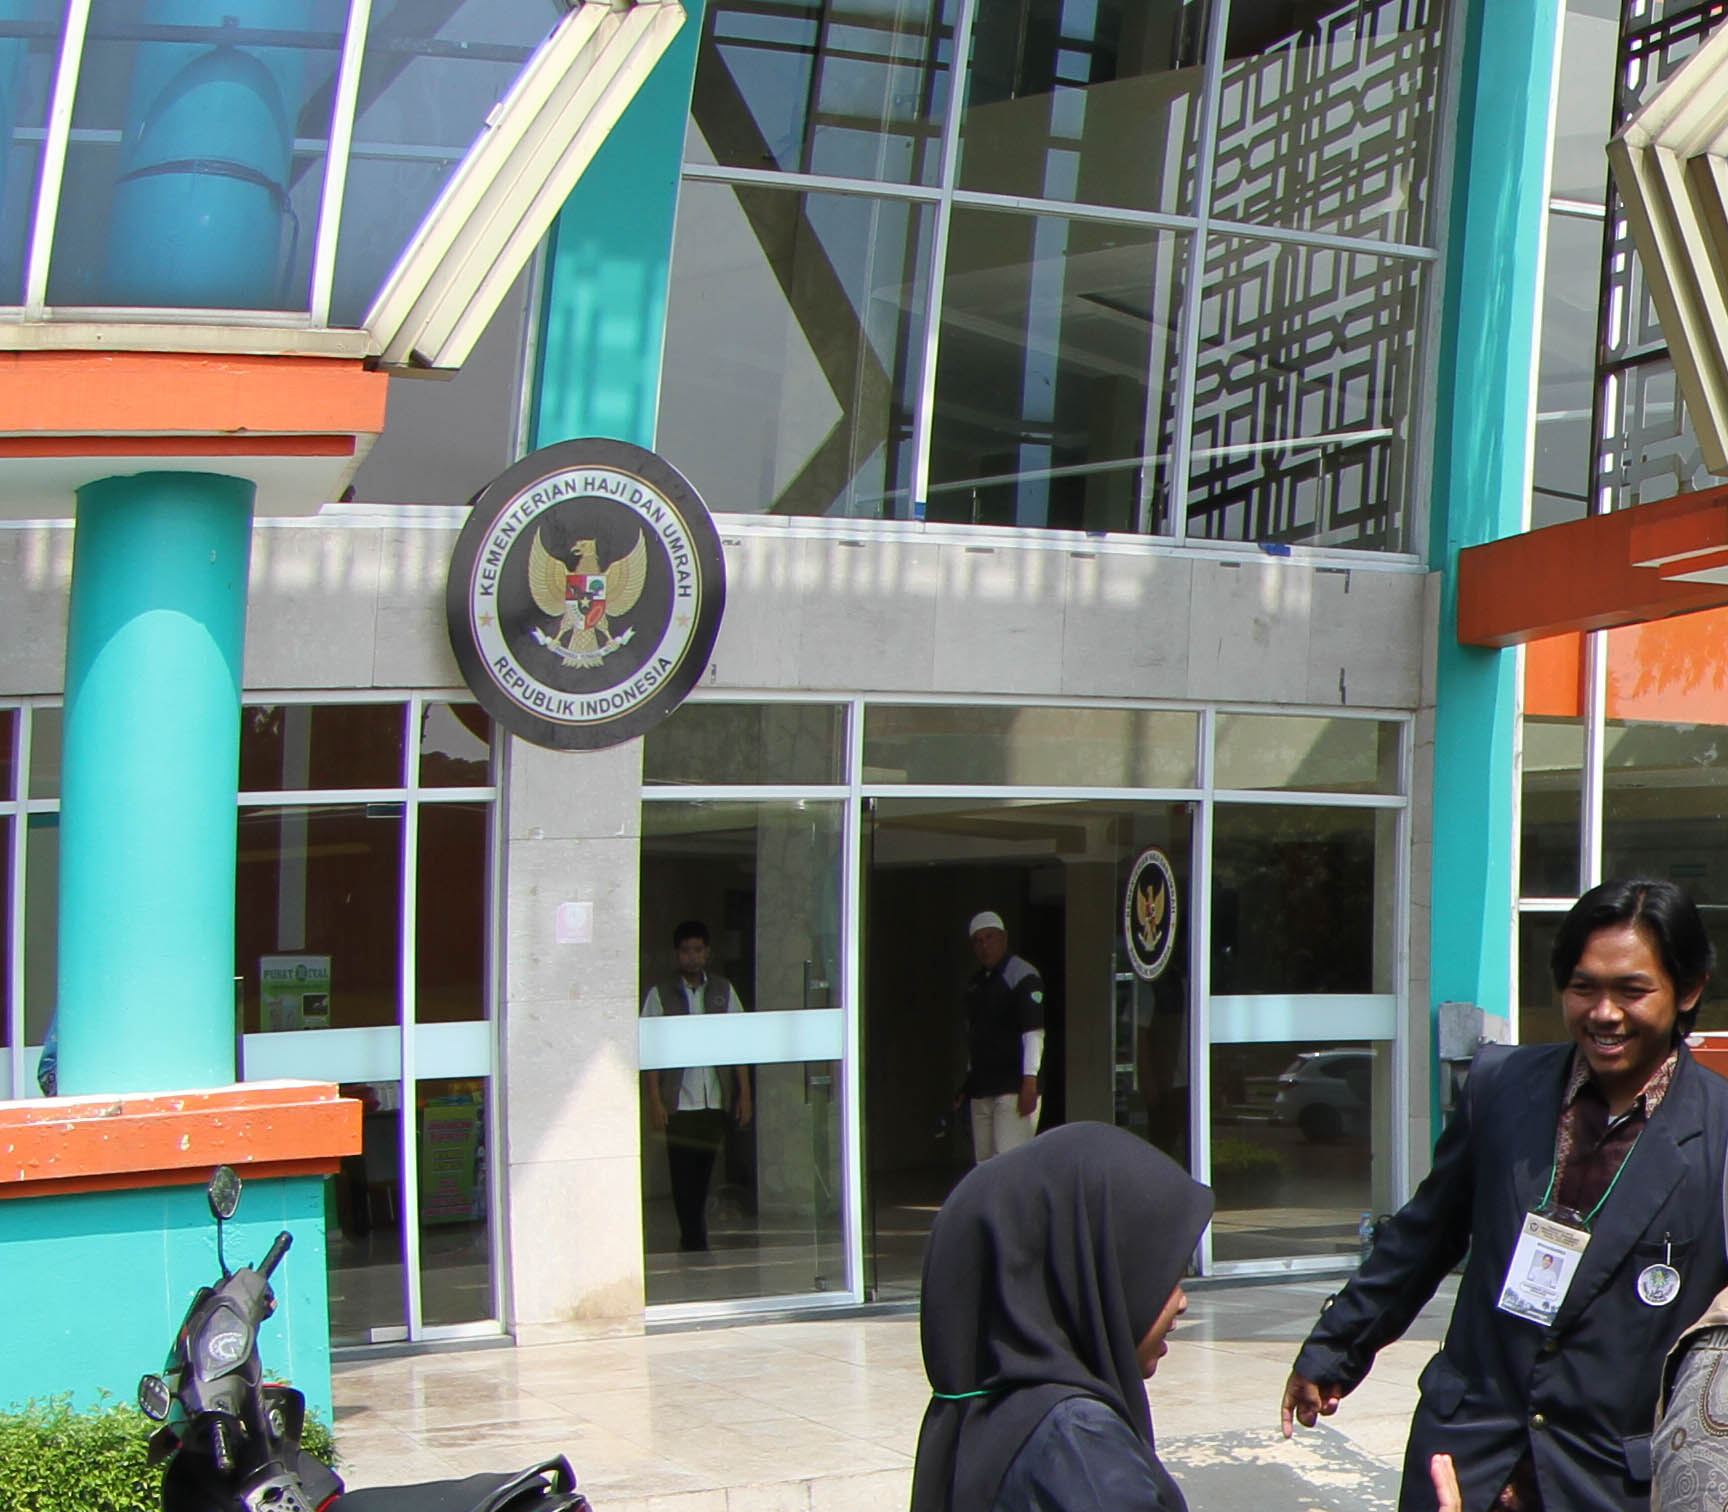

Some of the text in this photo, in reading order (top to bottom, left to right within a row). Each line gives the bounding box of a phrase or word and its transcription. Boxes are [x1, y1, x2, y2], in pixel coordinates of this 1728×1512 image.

[480, 475, 692, 598] KEMENTERIAN HAJI DAN UMRAH
[493, 656, 673, 716] REPUBLIK INDONESIA
